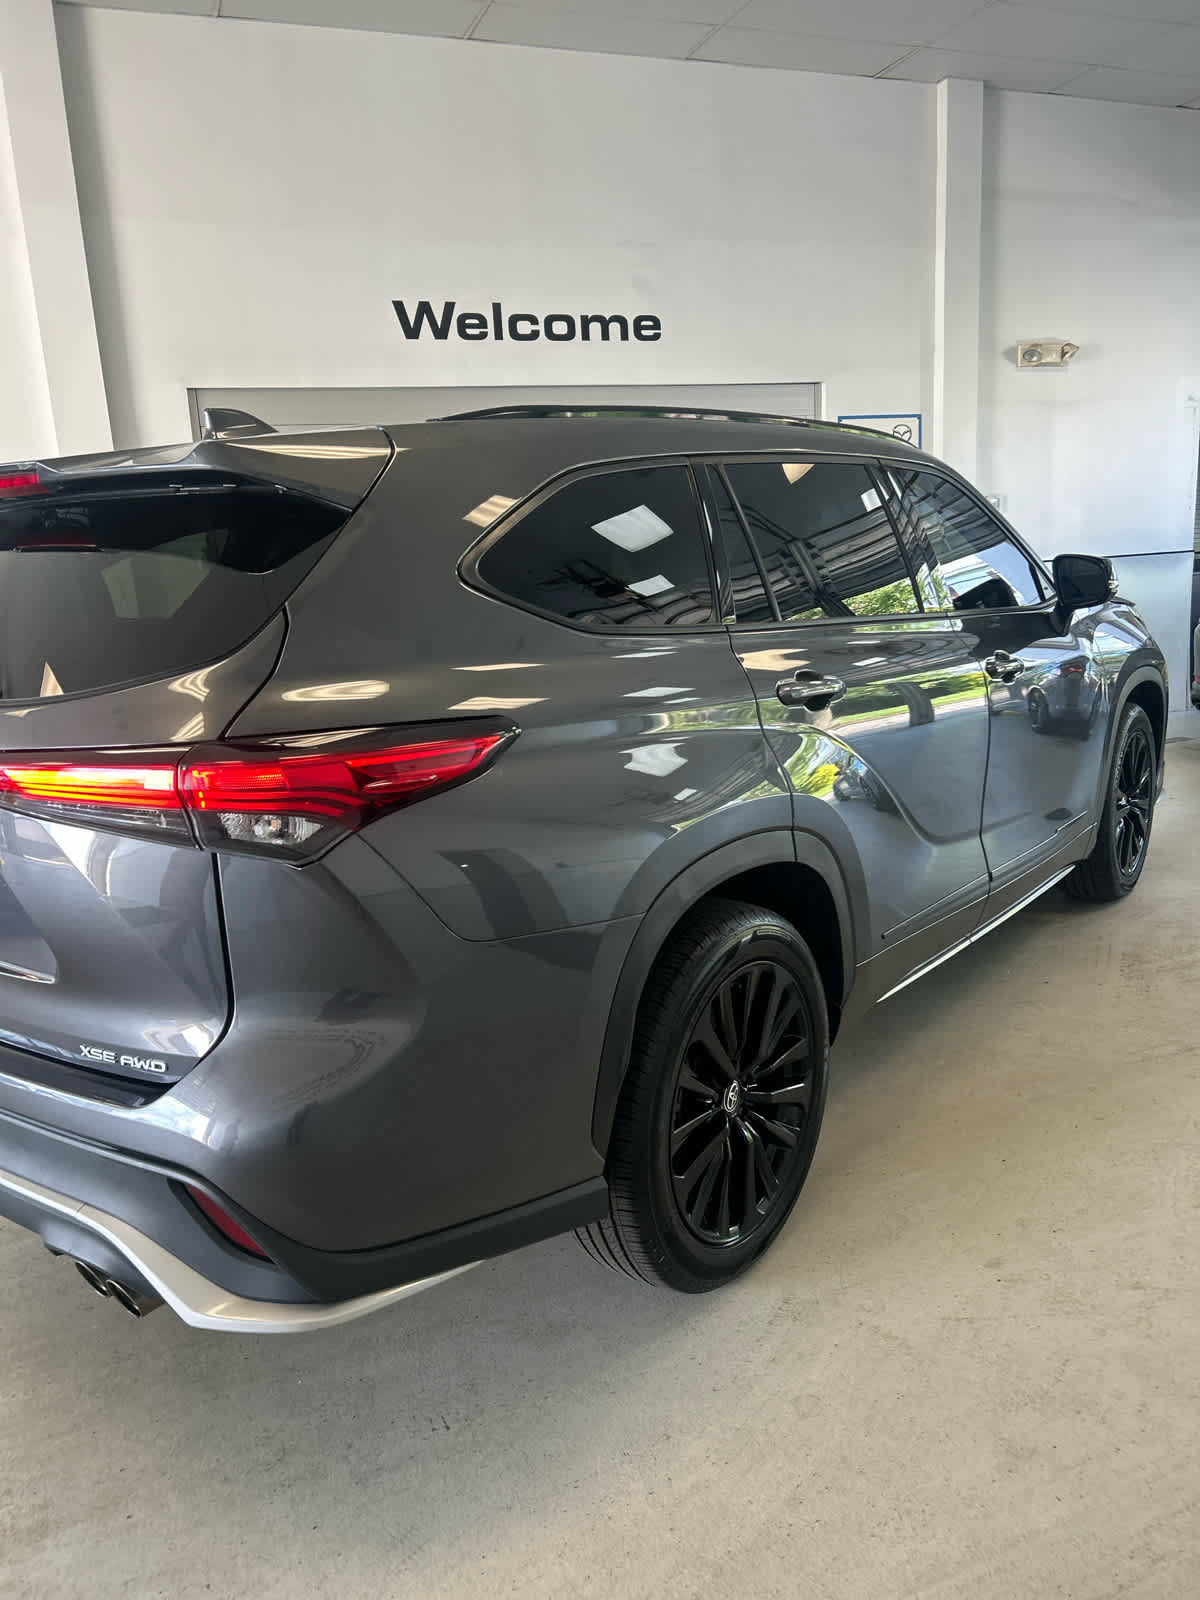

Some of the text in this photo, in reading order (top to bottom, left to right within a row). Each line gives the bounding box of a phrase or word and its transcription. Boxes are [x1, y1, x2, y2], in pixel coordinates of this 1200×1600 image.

[392, 300, 662, 342] Welcome
[79, 1044, 166, 1073] XSE AWD
